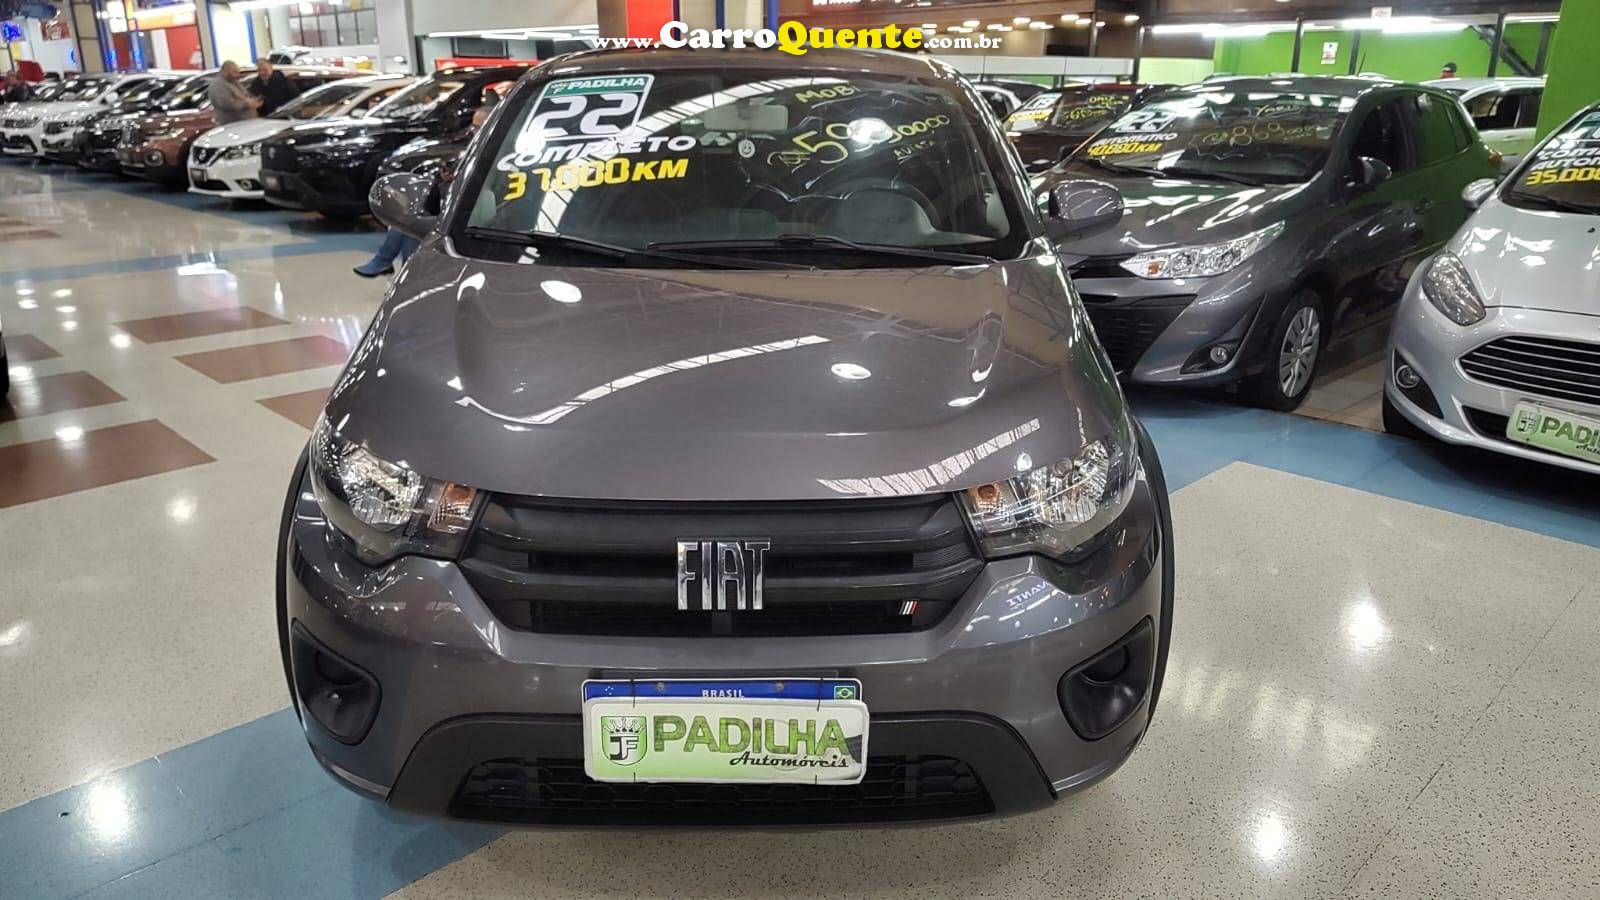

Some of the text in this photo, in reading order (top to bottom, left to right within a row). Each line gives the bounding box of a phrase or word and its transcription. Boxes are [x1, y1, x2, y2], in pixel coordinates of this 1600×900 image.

[567, 77, 645, 90] PADILHA
[794, 85, 861, 103] MOBI
[533, 93, 639, 136] 22
[1540, 147, 1600, 160] COM
[677, 541, 770, 611] FIAT
[702, 689, 745, 699] BRASIL
[653, 715, 852, 755] PADILHA
[729, 749, 849, 769] Automóveis
